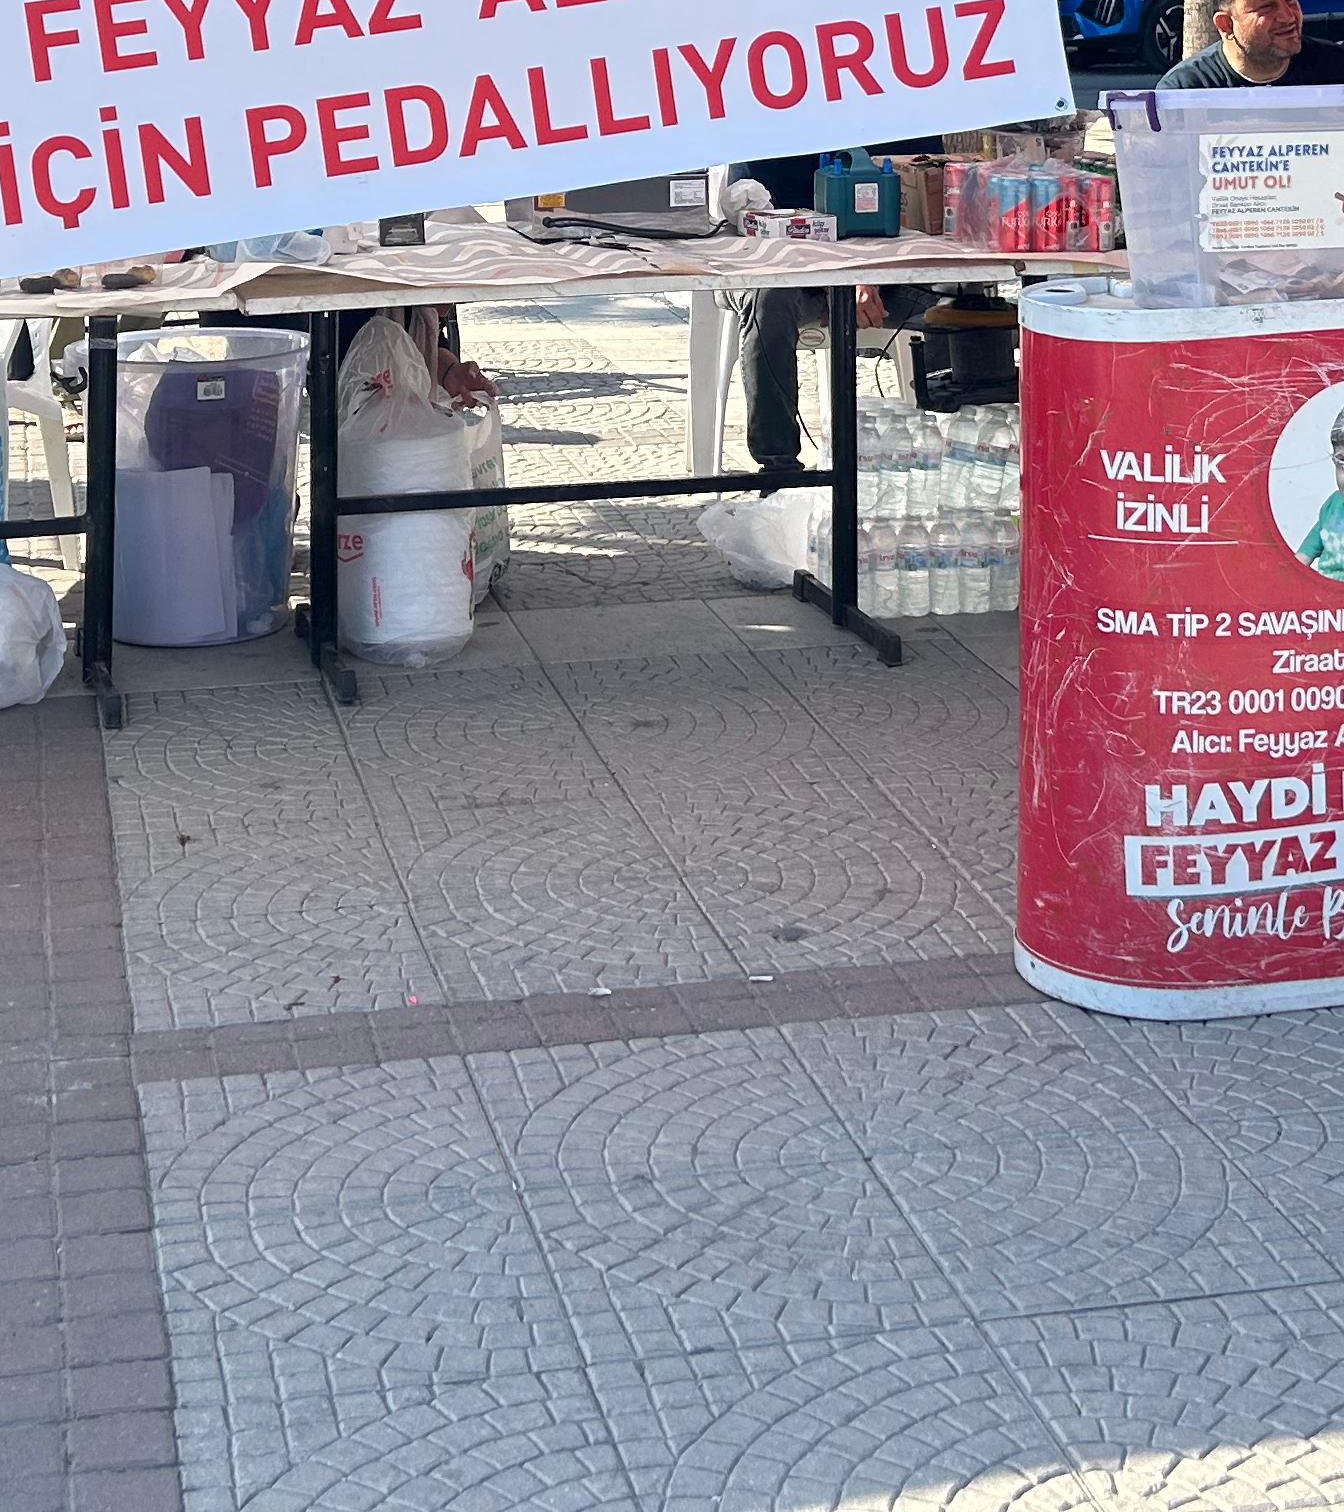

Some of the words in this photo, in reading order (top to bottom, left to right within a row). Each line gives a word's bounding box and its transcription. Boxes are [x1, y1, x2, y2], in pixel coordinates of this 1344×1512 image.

[1212, 145, 1264, 158] FEYYAZ
[1268, 144, 1329, 157] ALPEREN
[1212, 158, 1290, 173] CANTEKİN'E
[1212, 175, 1258, 190] UMUT
[1263, 175, 1292, 189] OL!
[1100, 445, 1227, 484] VALİLİK
[1116, 492, 1209, 534] İZİNLİ
[1097, 607, 1158, 636] SMA
[1167, 606, 1209, 637] TİP
[1215, 613, 1231, 636] 2
[1154, 689, 1221, 715] TR23
[1228, 688, 1284, 714] 0001
[1172, 727, 1232, 754] Alıcı:
[1238, 727, 1328, 760] Feyyaz
[1144, 762, 1327, 827] HAYDİ
[1140, 830, 1337, 886] FEYYAZ
[1166, 891, 1309, 953] Seninle
